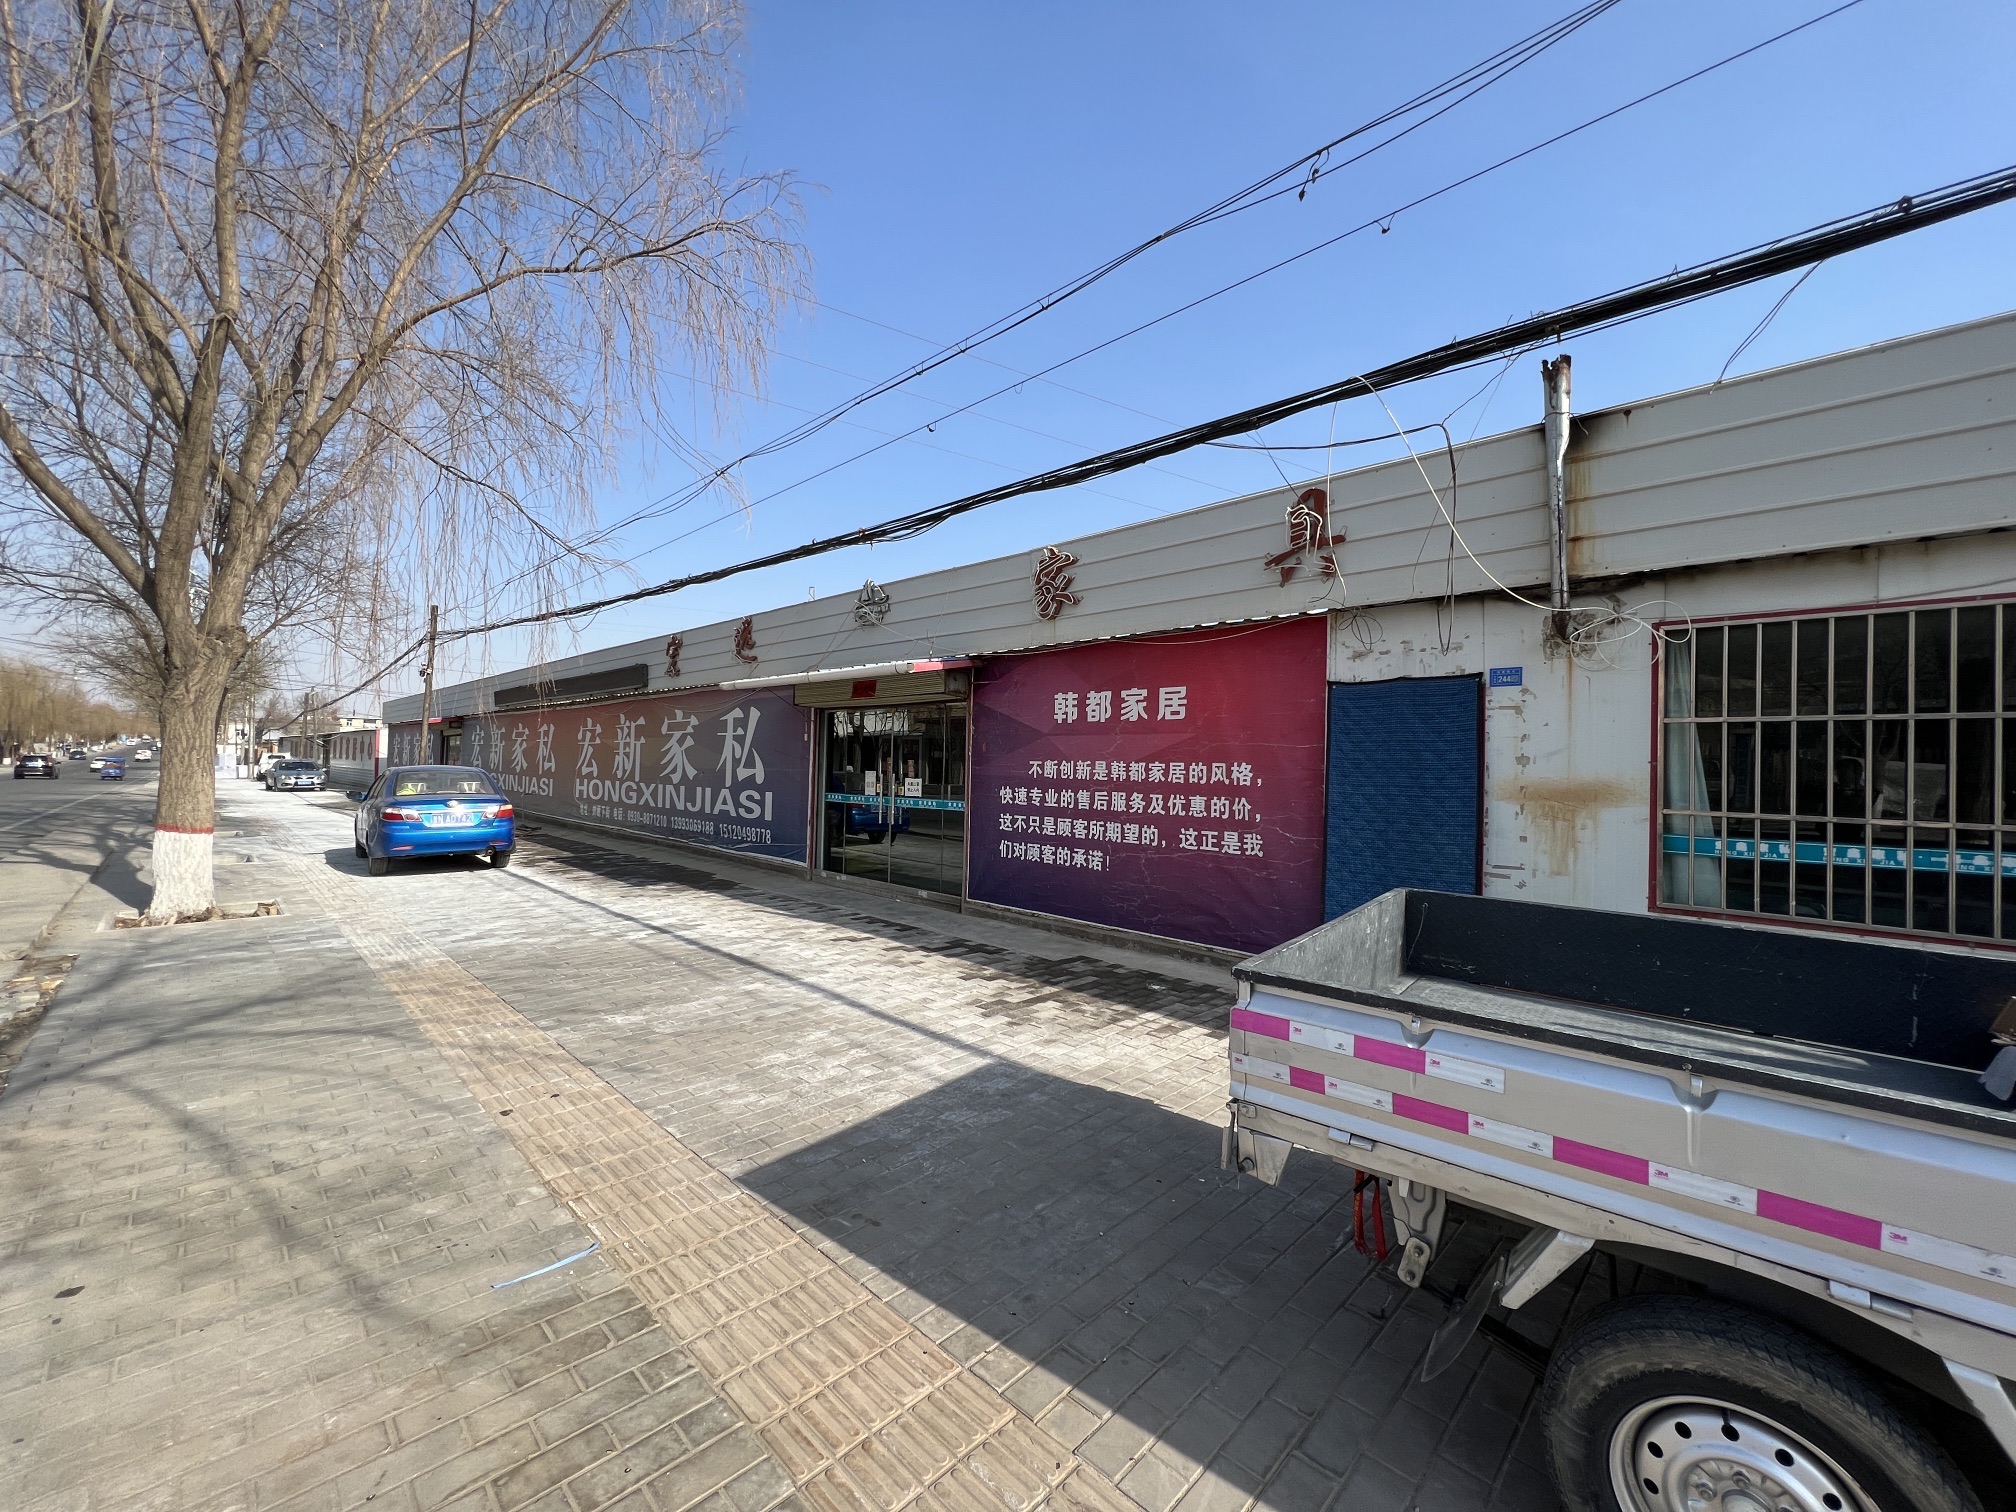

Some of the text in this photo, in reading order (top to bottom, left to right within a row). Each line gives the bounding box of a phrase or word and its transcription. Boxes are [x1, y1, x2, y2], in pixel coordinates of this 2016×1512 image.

[1053, 686, 1188, 724] 韩都家居
[471, 723, 556, 775] 宏新家私
[576, 706, 765, 787] 宏新家私
[575, 778, 773, 821] HONGXINJIASI
[671, 816, 714, 835] 13993069188
[720, 823, 771, 844] 15120498778
[1429, 1058, 1440, 1066] 3M
[1473, 1120, 1484, 1128] 3M
[1654, 1169, 1669, 1178] 3M
[1889, 1231, 1908, 1241] 3M
